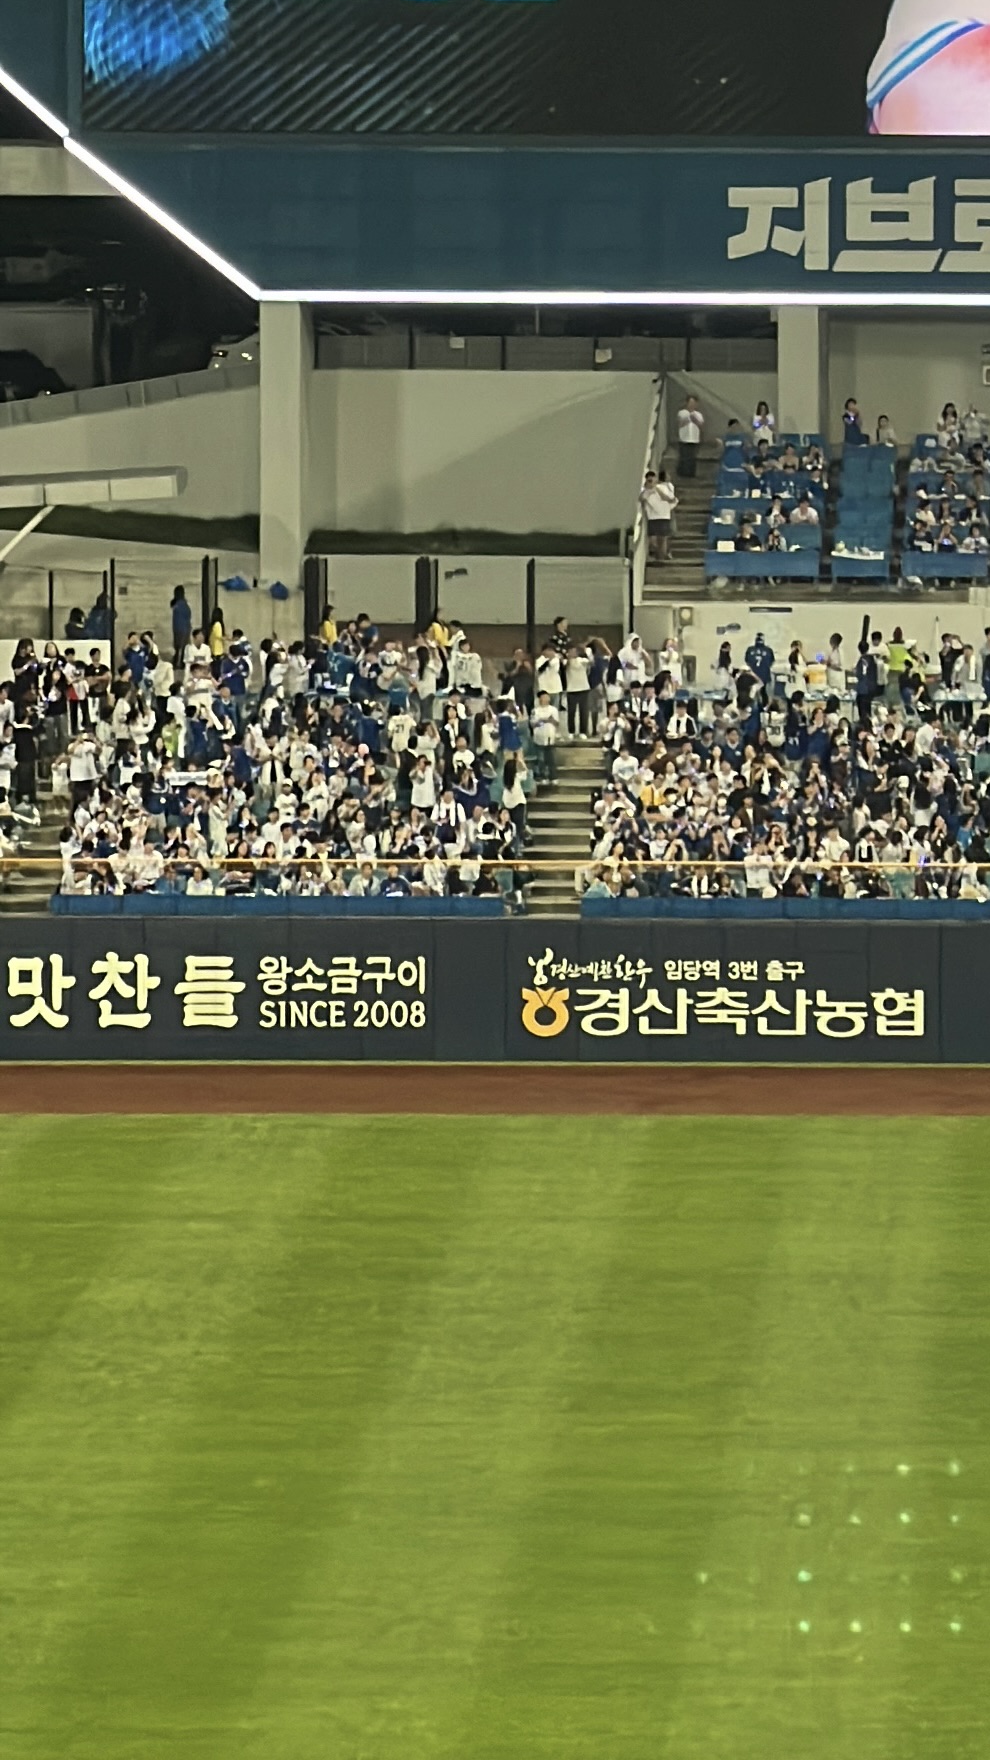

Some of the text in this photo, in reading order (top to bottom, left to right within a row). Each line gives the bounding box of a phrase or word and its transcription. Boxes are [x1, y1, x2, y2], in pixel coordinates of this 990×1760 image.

[7, 951, 246, 1029] 맛찬들
[257, 955, 426, 995] 왕소금구이
[664, 959, 806, 982] 임당역 3번 출구
[259, 1000, 426, 1028] SINCE 2008
[573, 986, 925, 1038] 경산축산농협
